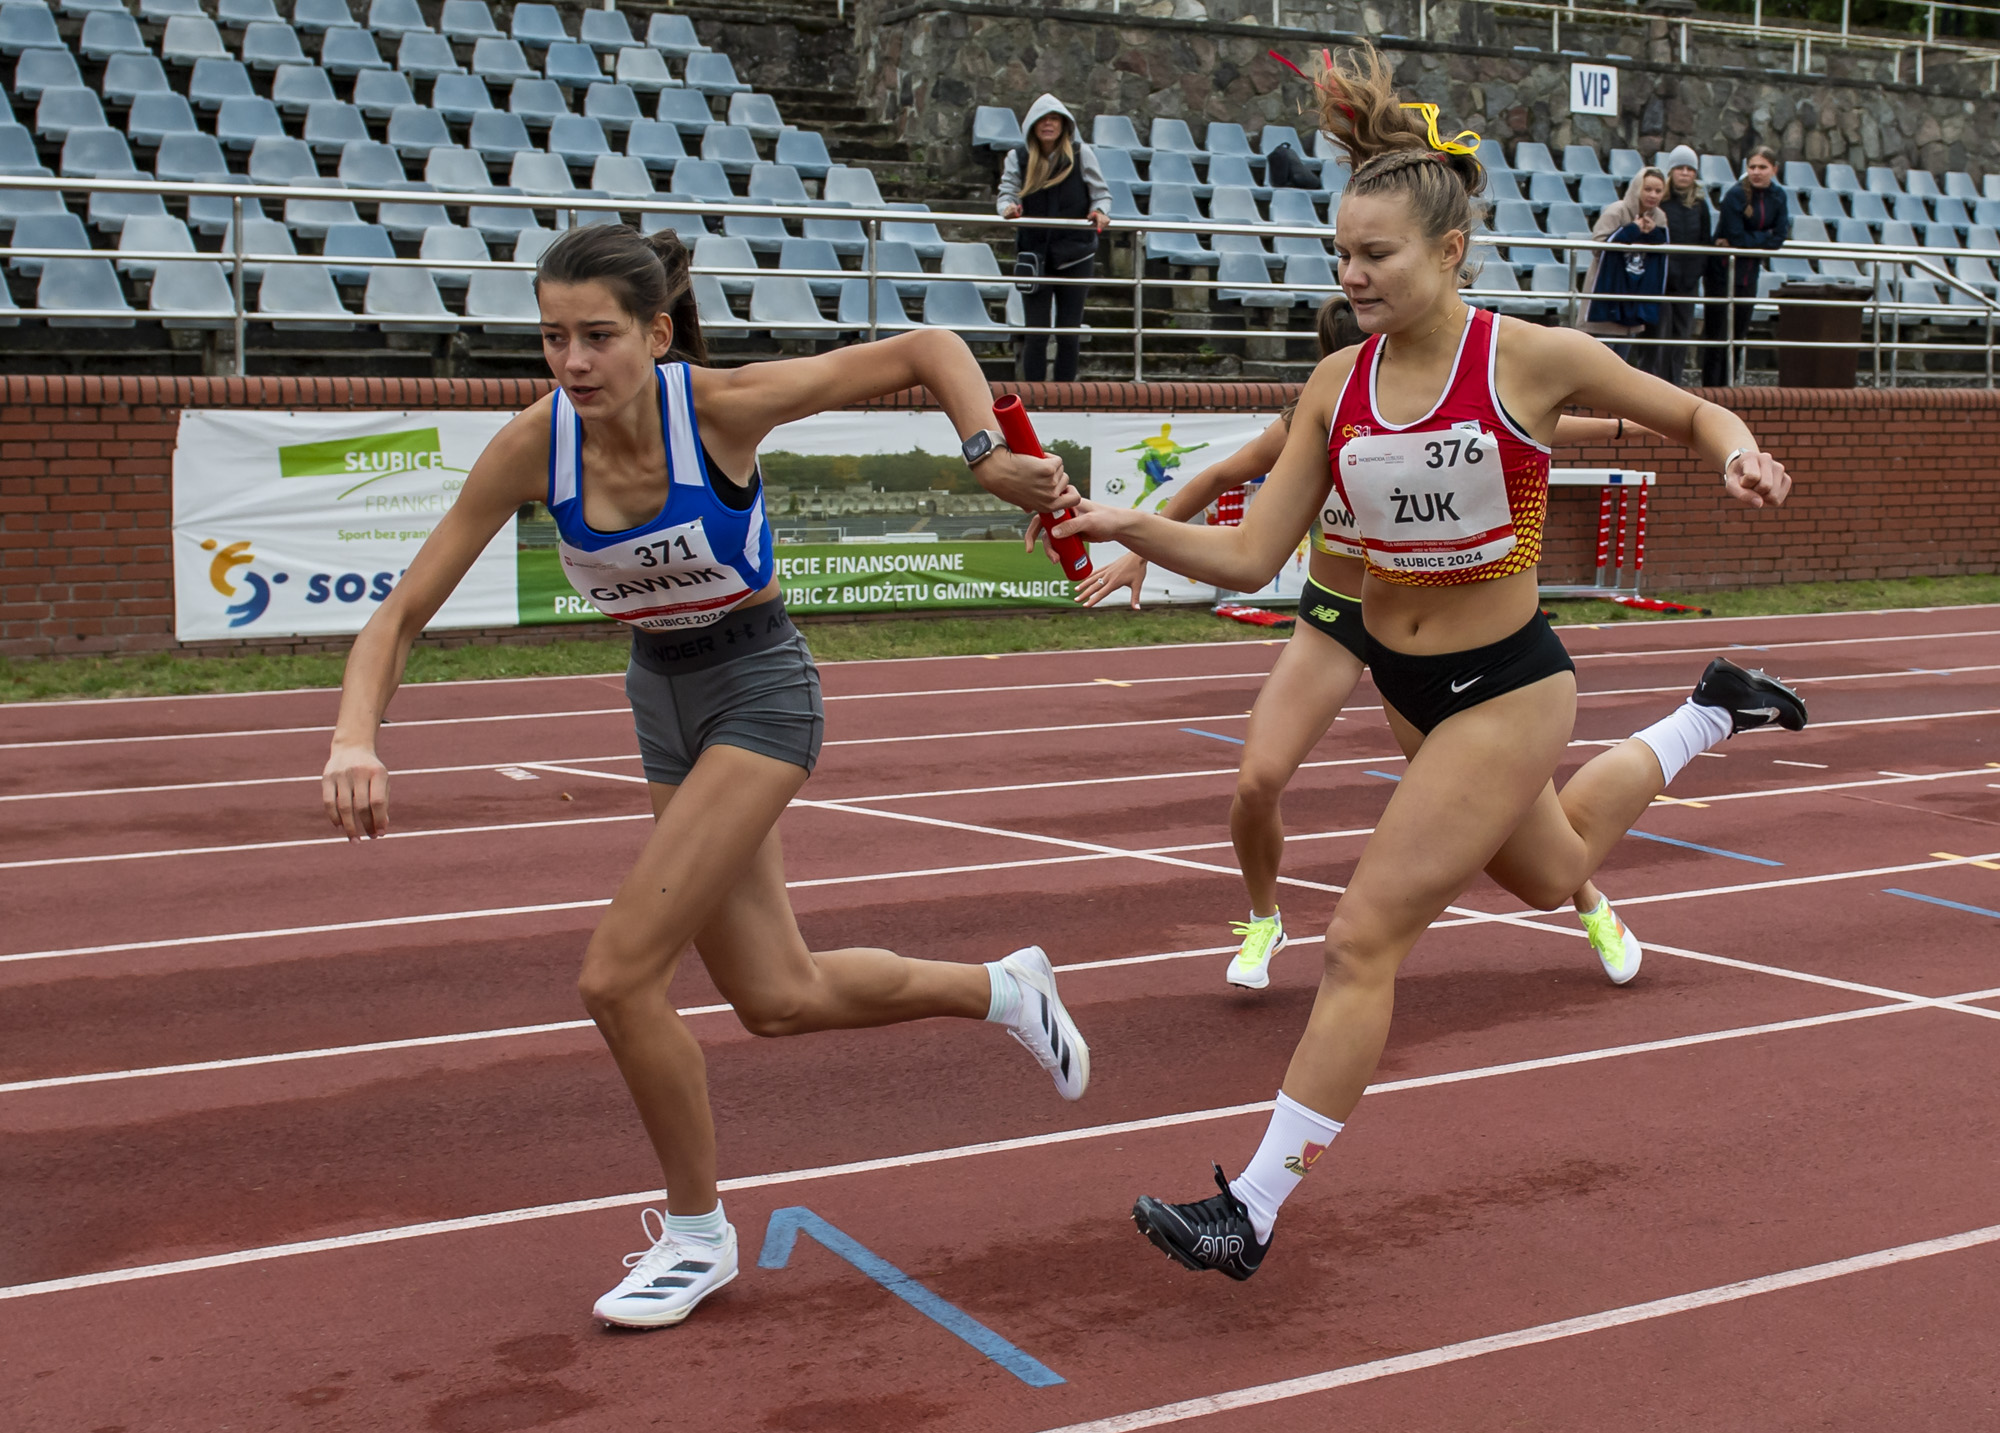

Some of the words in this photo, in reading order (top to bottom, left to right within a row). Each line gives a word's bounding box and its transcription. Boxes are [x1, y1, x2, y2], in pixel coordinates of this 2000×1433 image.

[1579, 71, 1610, 107] VIP
[344, 451, 443, 471] SŁUBICE
[1425, 438, 1484, 468] 376
[442, 480, 466, 491] OD
[365, 494, 460, 513] FRANKFU
[1390, 487, 1461, 524] ŻUK
[1324, 509, 1356, 528] OW
[338, 529, 371, 542] Sport
[375, 528, 397, 540] bez
[634, 535, 698, 568] 371
[1347, 547, 1363, 556] SŁU
[1393, 557, 1445, 568] SŁUBICE
[1447, 551, 1483, 567] 2024
[773, 557, 820, 579] IĘCIE
[826, 554, 964, 575] FINANSOWANE
[305, 569, 406, 604] SOS
[590, 567, 727, 601] GAWLIK
[554, 595, 601, 614] PRZ
[826, 586, 838, 604] Z
[843, 581, 928, 604] BUDŻETU
[933, 582, 995, 601] GMINY
[1000, 580, 1069, 598] SŁUBICE
[641, 616, 693, 630] SŁUBICE
[693, 610, 728, 625] 2024
[766, 608, 789, 634] AR
